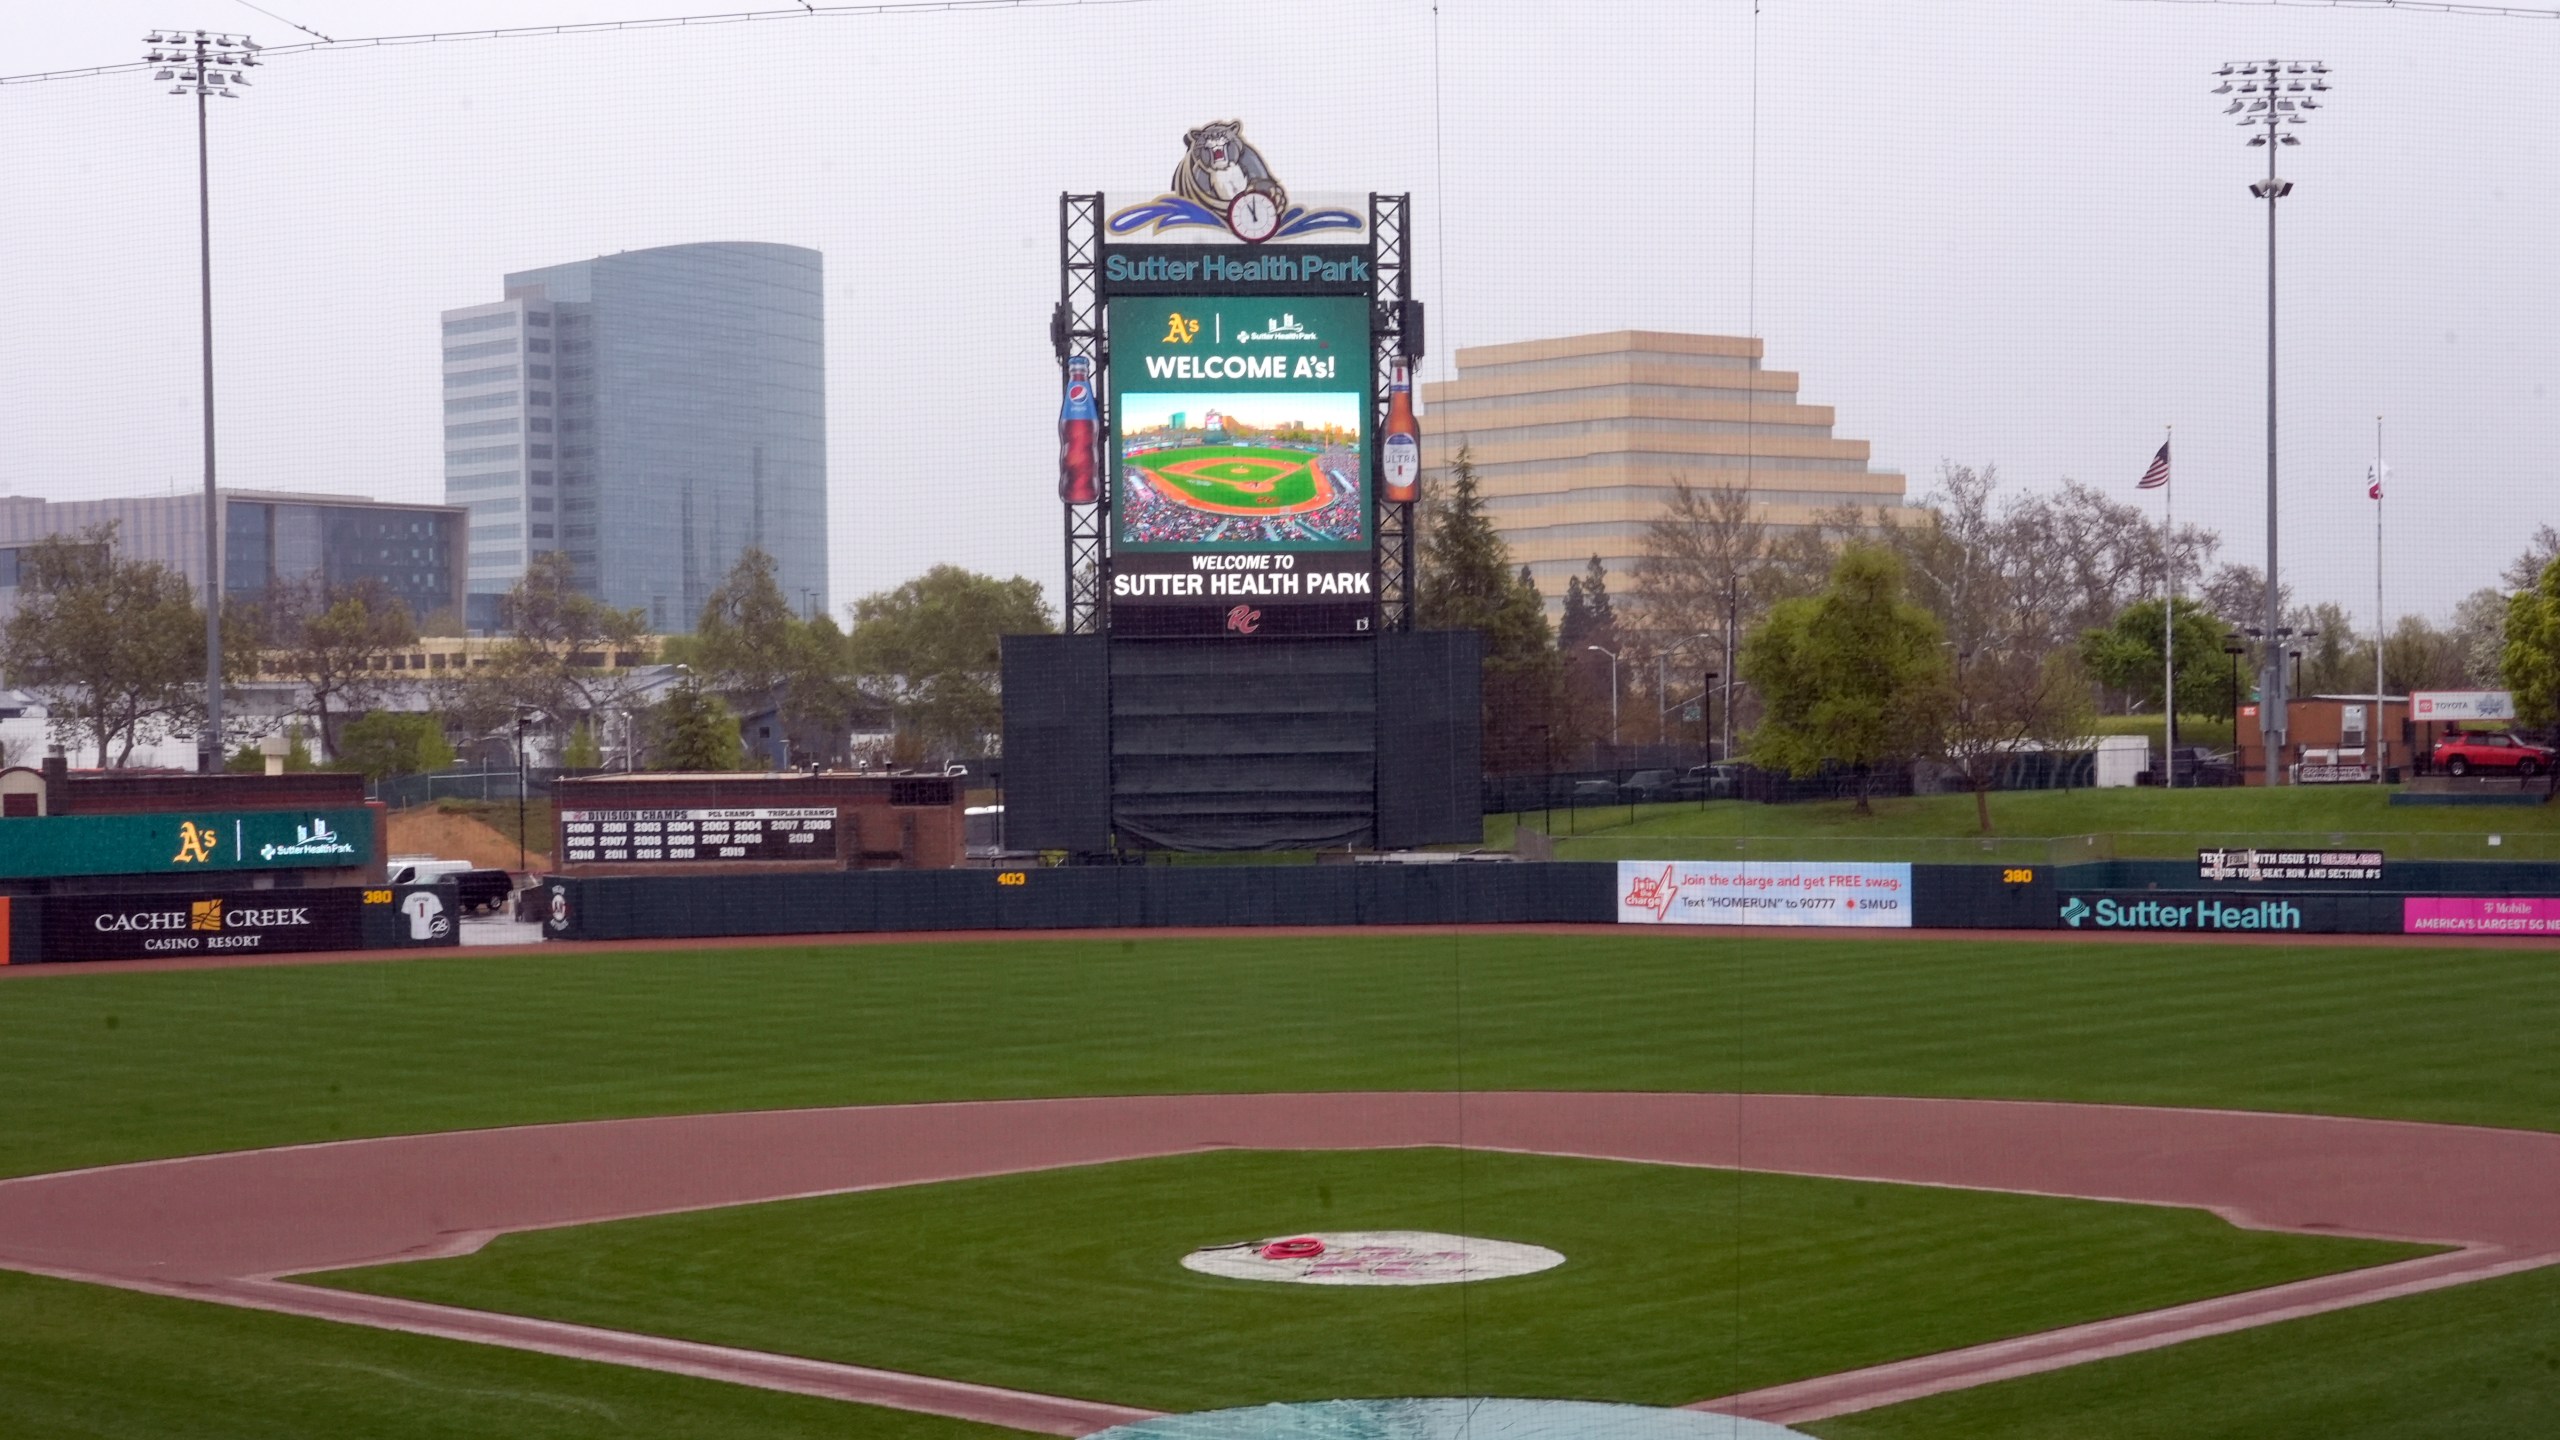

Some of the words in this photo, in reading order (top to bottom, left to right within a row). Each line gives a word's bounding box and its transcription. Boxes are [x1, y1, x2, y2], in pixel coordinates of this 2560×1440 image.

[1106, 254, 1199, 282] Sutter
[1203, 255, 1298, 281] Health
[1302, 255, 1370, 281] Park
[1162, 312, 1200, 343] A's
[1146, 355, 1287, 379] WELCOME
[1293, 355, 1336, 379] A's!
[1385, 454, 1416, 464] ULTRA
[1192, 555, 1270, 570] WELCOME
[1273, 555, 1295, 570] TO
[1114, 573, 1204, 596] SUTTER
[1211, 573, 1300, 596] HEALTH
[1307, 573, 1371, 595] PARK
[1227, 604, 1262, 634] RC
[2435, 702, 2468, 711] TOYOTA
[588, 811, 638, 821] DIVISION
[641, 810, 688, 820] CHAMPS
[804, 809, 834, 817] CHAMPS
[567, 822, 595, 833] 2000
[602, 822, 627, 832] 2001
[633, 822, 661, 832] 2003
[667, 821, 694, 832] 2004
[734, 820, 762, 831] 2004
[770, 820, 799, 831] 2007
[173, 820, 217, 863] A's
[600, 836, 627, 846] 2007
[701, 834, 730, 844] 2007
[788, 833, 814, 843] 2019
[277, 845, 303, 855] Sutter
[304, 844, 331, 854] Health
[569, 849, 595, 860] 2010
[604, 849, 628, 859] 2011
[636, 848, 662, 859] 2012
[669, 848, 695, 859] 2019
[720, 846, 745, 857] 2019
[2200, 852, 2226, 864] TEXT
[2252, 853, 2277, 864] WITH
[2279, 853, 2306, 864] ISSUE
[2307, 854, 2320, 864] TO
[997, 872, 1025, 885] 403
[2003, 869, 2032, 883] 380
[2201, 868, 2236, 878] INCLUDE
[2238, 868, 2261, 878] YOUR
[2308, 868, 2327, 878] AND
[2328, 868, 2364, 878] SECTION
[1682, 874, 1705, 886] Join
[1709, 874, 1729, 885] the
[1733, 874, 1774, 890] charge
[1777, 874, 1800, 887] and
[1804, 877, 1825, 890] get
[1829, 875, 1861, 887] FREE
[1865, 878, 1902, 891] swag.
[363, 890, 393, 904] 380
[1682, 897, 1705, 908] Text
[1708, 897, 1783, 909] "HOMERUN"
[1786, 898, 1798, 908] to
[1800, 898, 1836, 909] 90777
[419, 902, 425, 918] 1
[1860, 899, 1898, 910] SMUD
[2496, 902, 2532, 914] Mobile
[2095, 898, 2192, 927] Sutter
[2198, 900, 2300, 928] Health
[95, 911, 187, 932] CACHE
[225, 907, 311, 928] CREEK
[2415, 918, 2475, 929] AMERICA'S
[2477, 918, 2526, 929] LARGEST
[2529, 919, 2544, 930] 5G
[145, 938, 199, 950] CASINO
[207, 935, 262, 949] RESORT
